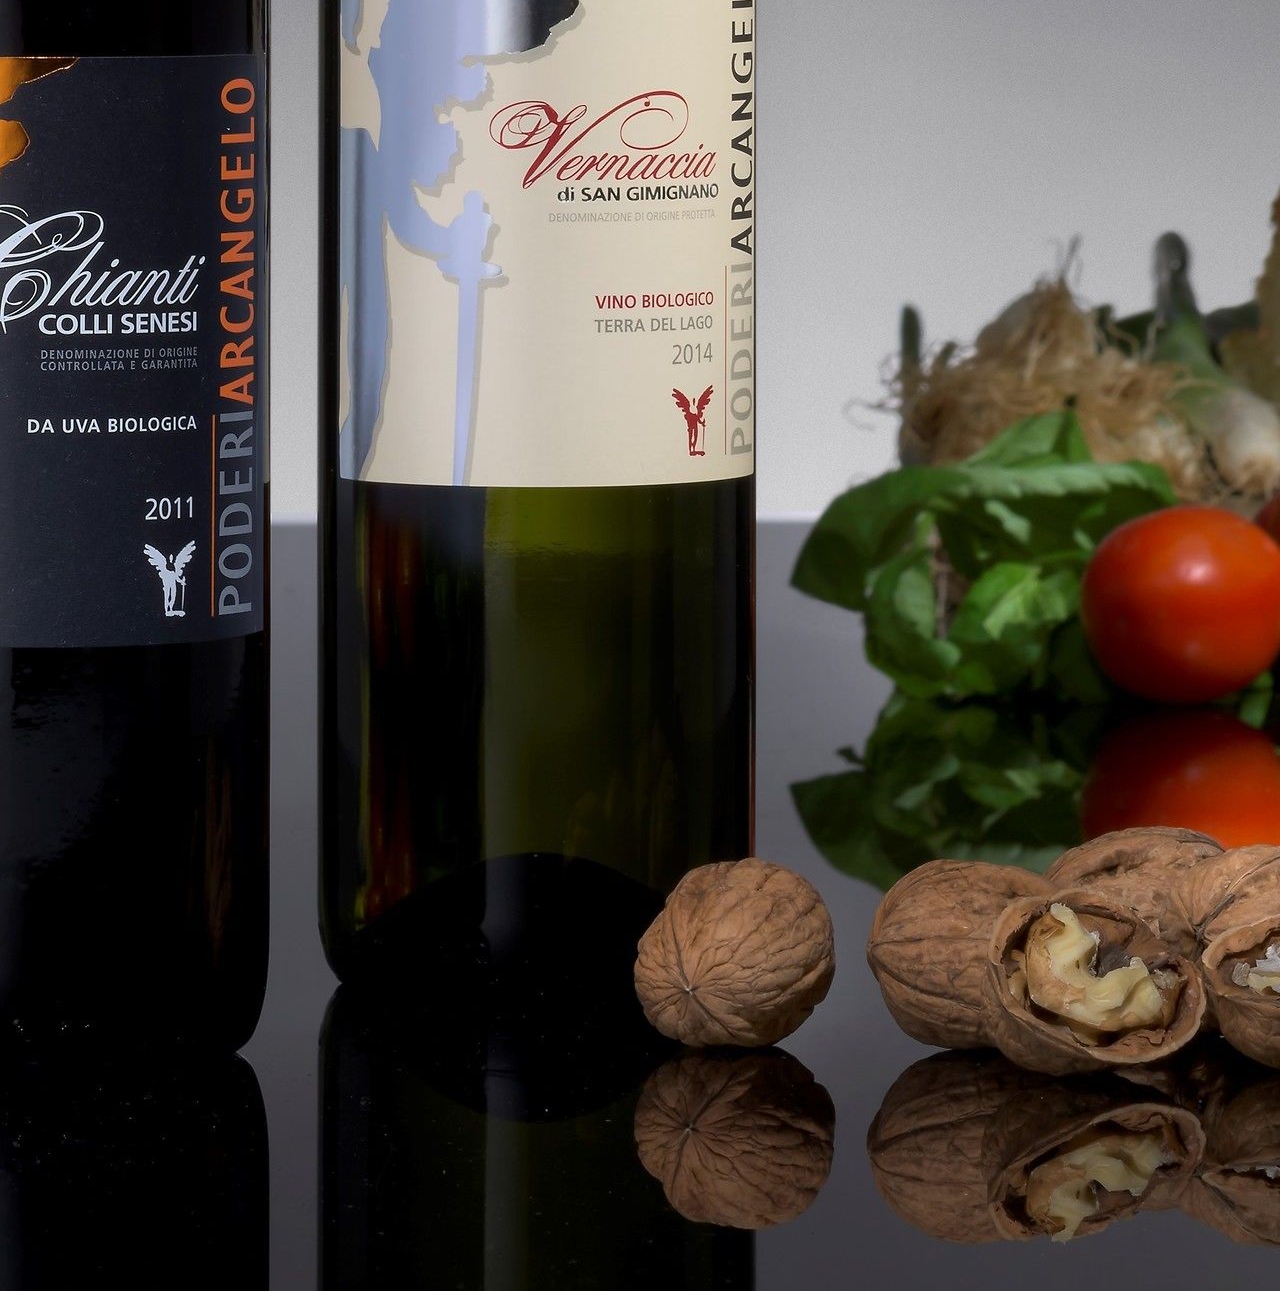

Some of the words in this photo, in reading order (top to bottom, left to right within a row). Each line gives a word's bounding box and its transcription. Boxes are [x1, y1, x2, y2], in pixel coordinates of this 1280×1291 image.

[489, 90, 718, 190] Vernaccia
[557, 186, 575, 202] di
[581, 186, 621, 202] SAN
[626, 183, 719, 202] GIMIGNANO
[548, 212, 632, 223] DENOMINAZIONE
[634, 212, 645, 222] DI
[647, 211, 679, 222] ORIGINE
[681, 208, 716, 221] PROTETTA
[594, 294, 637, 310] VINO
[642, 291, 714, 309] BIOLOGICO
[38, 313, 113, 335] COLLI
[120, 311, 198, 334] SENESI
[594, 318, 646, 334] TERRA
[650, 317, 677, 332] DEL
[680, 314, 714, 331] LAGO
[40, 348, 140, 360] DENOMINAZIONE
[143, 348, 155, 359] DI
[158, 346, 198, 358] ORIGINE
[672, 342, 713, 365] 2014
[40, 360, 125, 372] CONTROLLATA
[130, 360, 136, 370] E
[141, 357, 198, 370] GARANTITA
[27, 418, 55, 433] DA
[62, 418, 101, 433] UVA
[107, 415, 198, 433] BIOLOGICA
[145, 496, 193, 521] 2011
